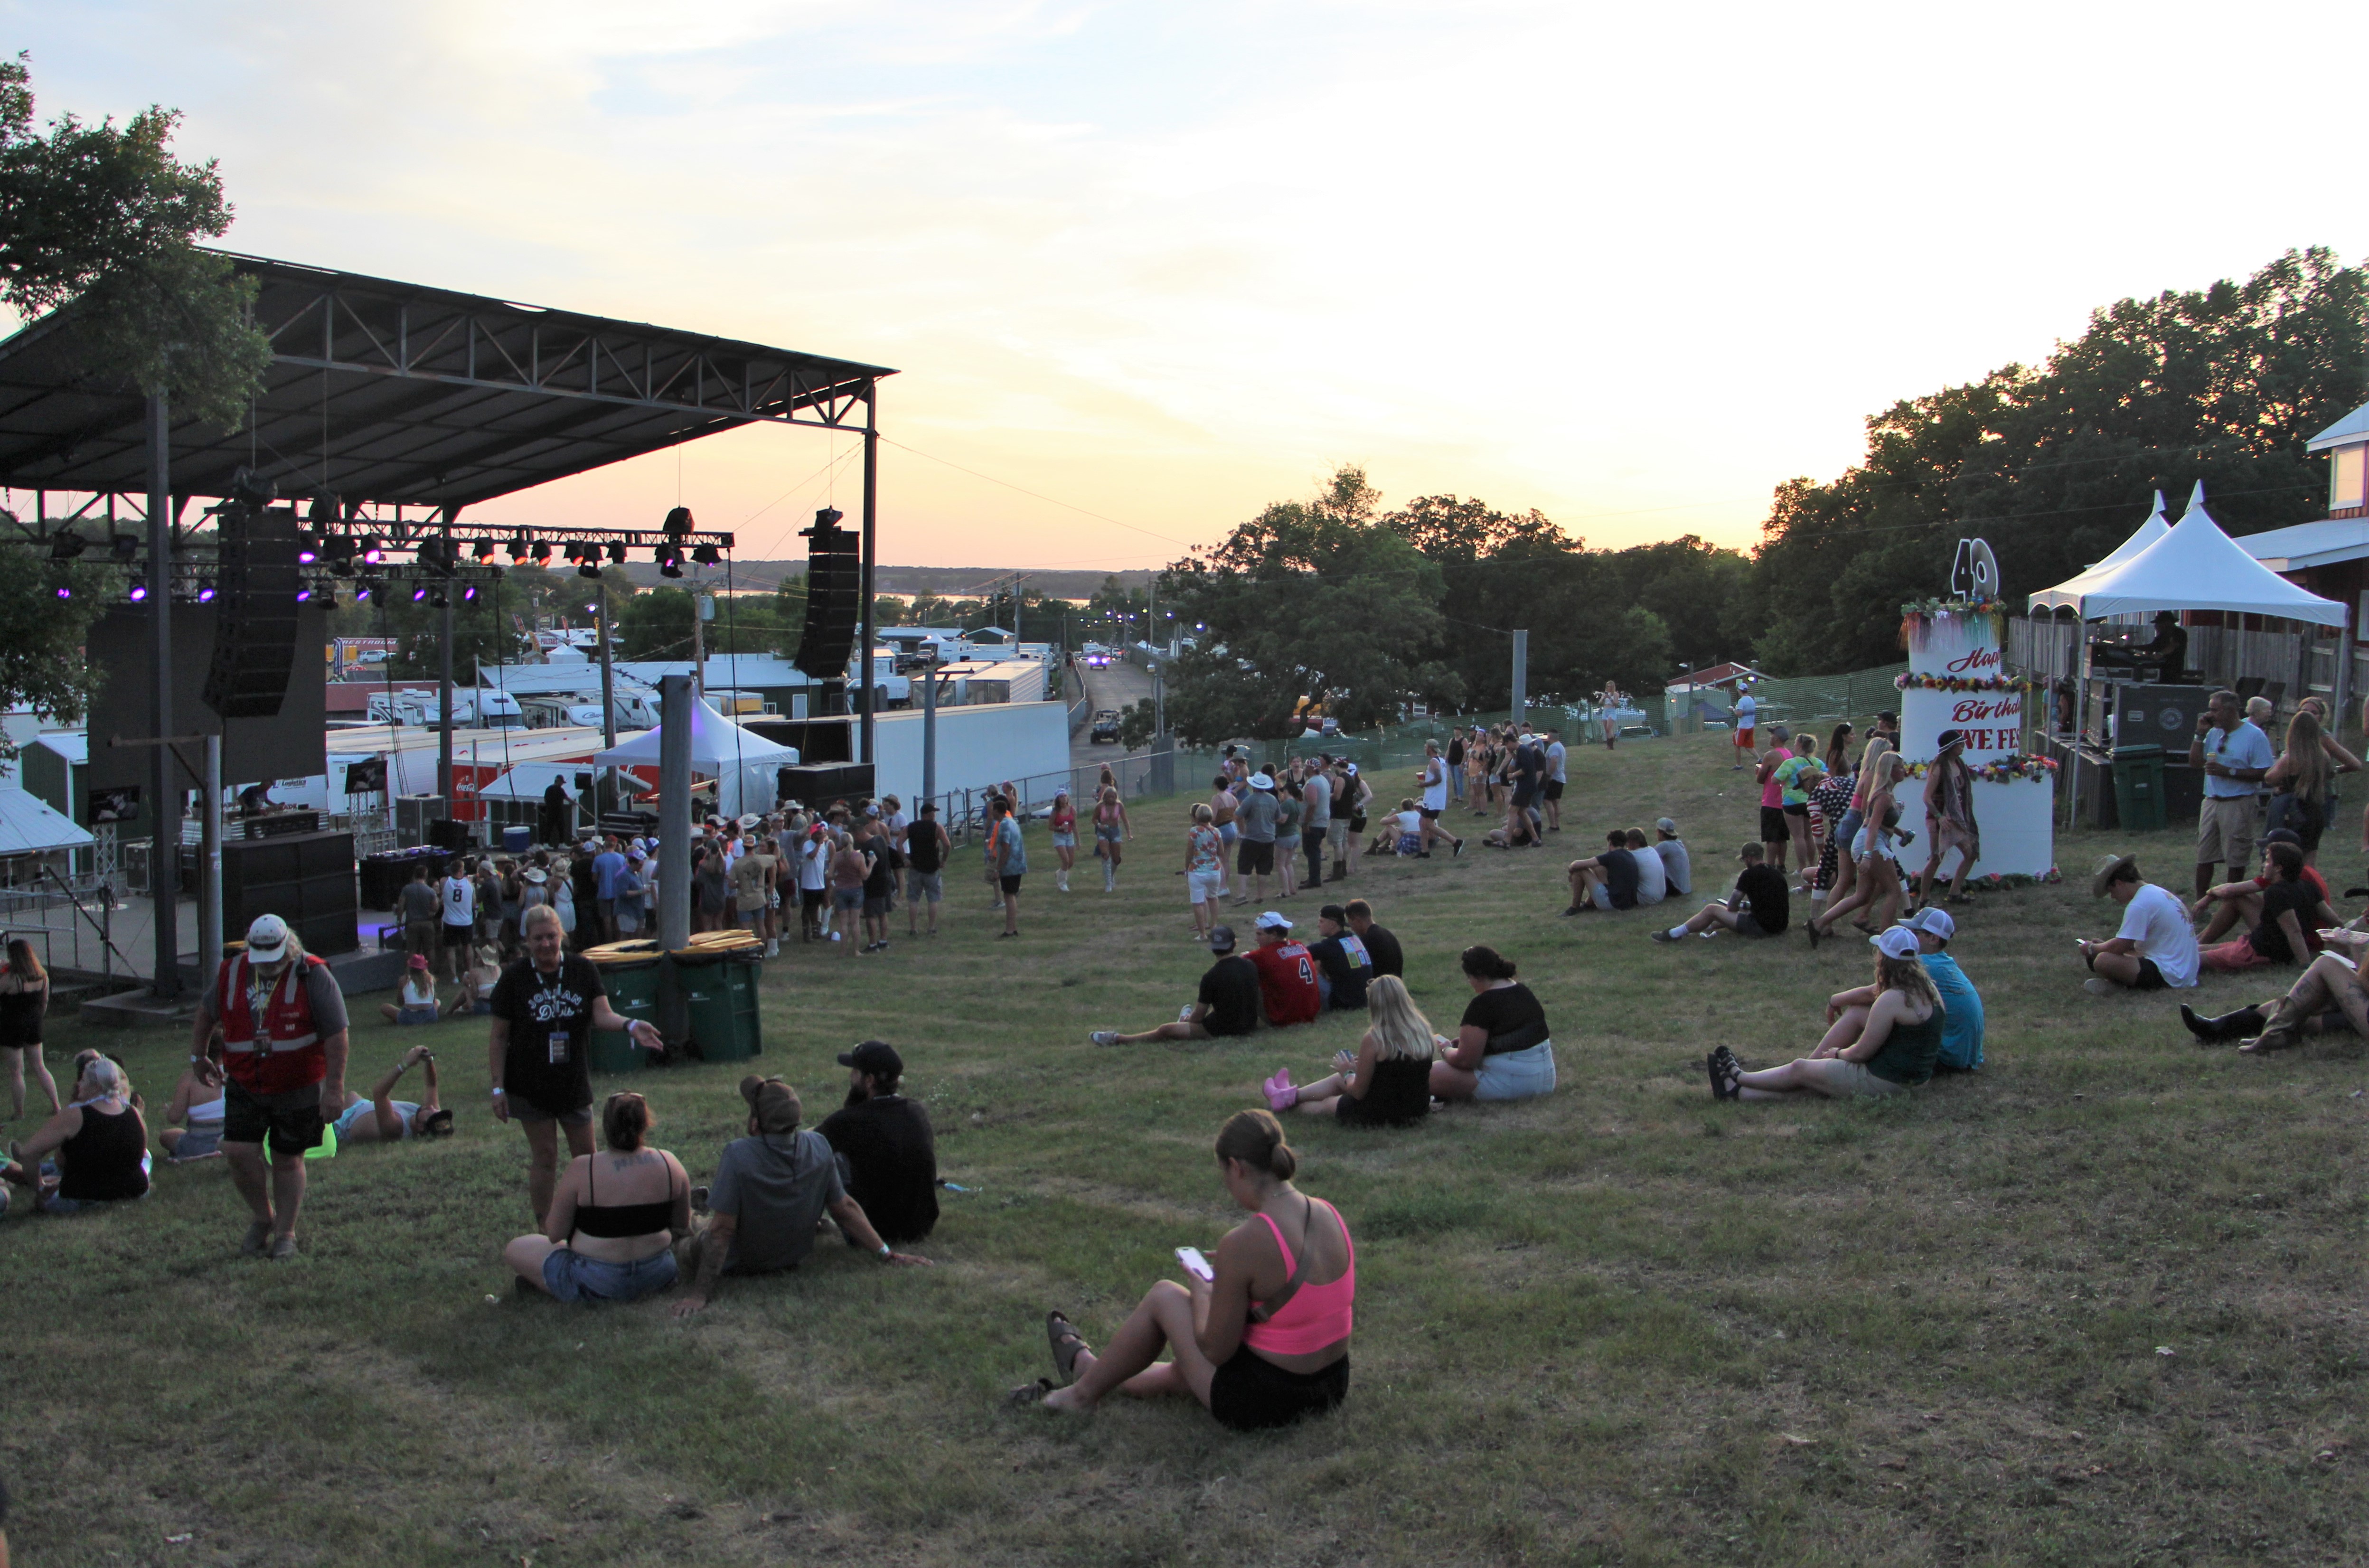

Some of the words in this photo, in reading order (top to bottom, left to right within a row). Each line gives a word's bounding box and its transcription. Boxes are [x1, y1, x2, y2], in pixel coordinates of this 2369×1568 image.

[1951, 538, 1998, 604] 40
[1955, 729, 1993, 750] WE
[456, 782, 475, 792] Coca-Col
[453, 889, 462, 902] 8
[1298, 957, 1313, 984] 4
[528, 988, 583, 1009] JOAN
